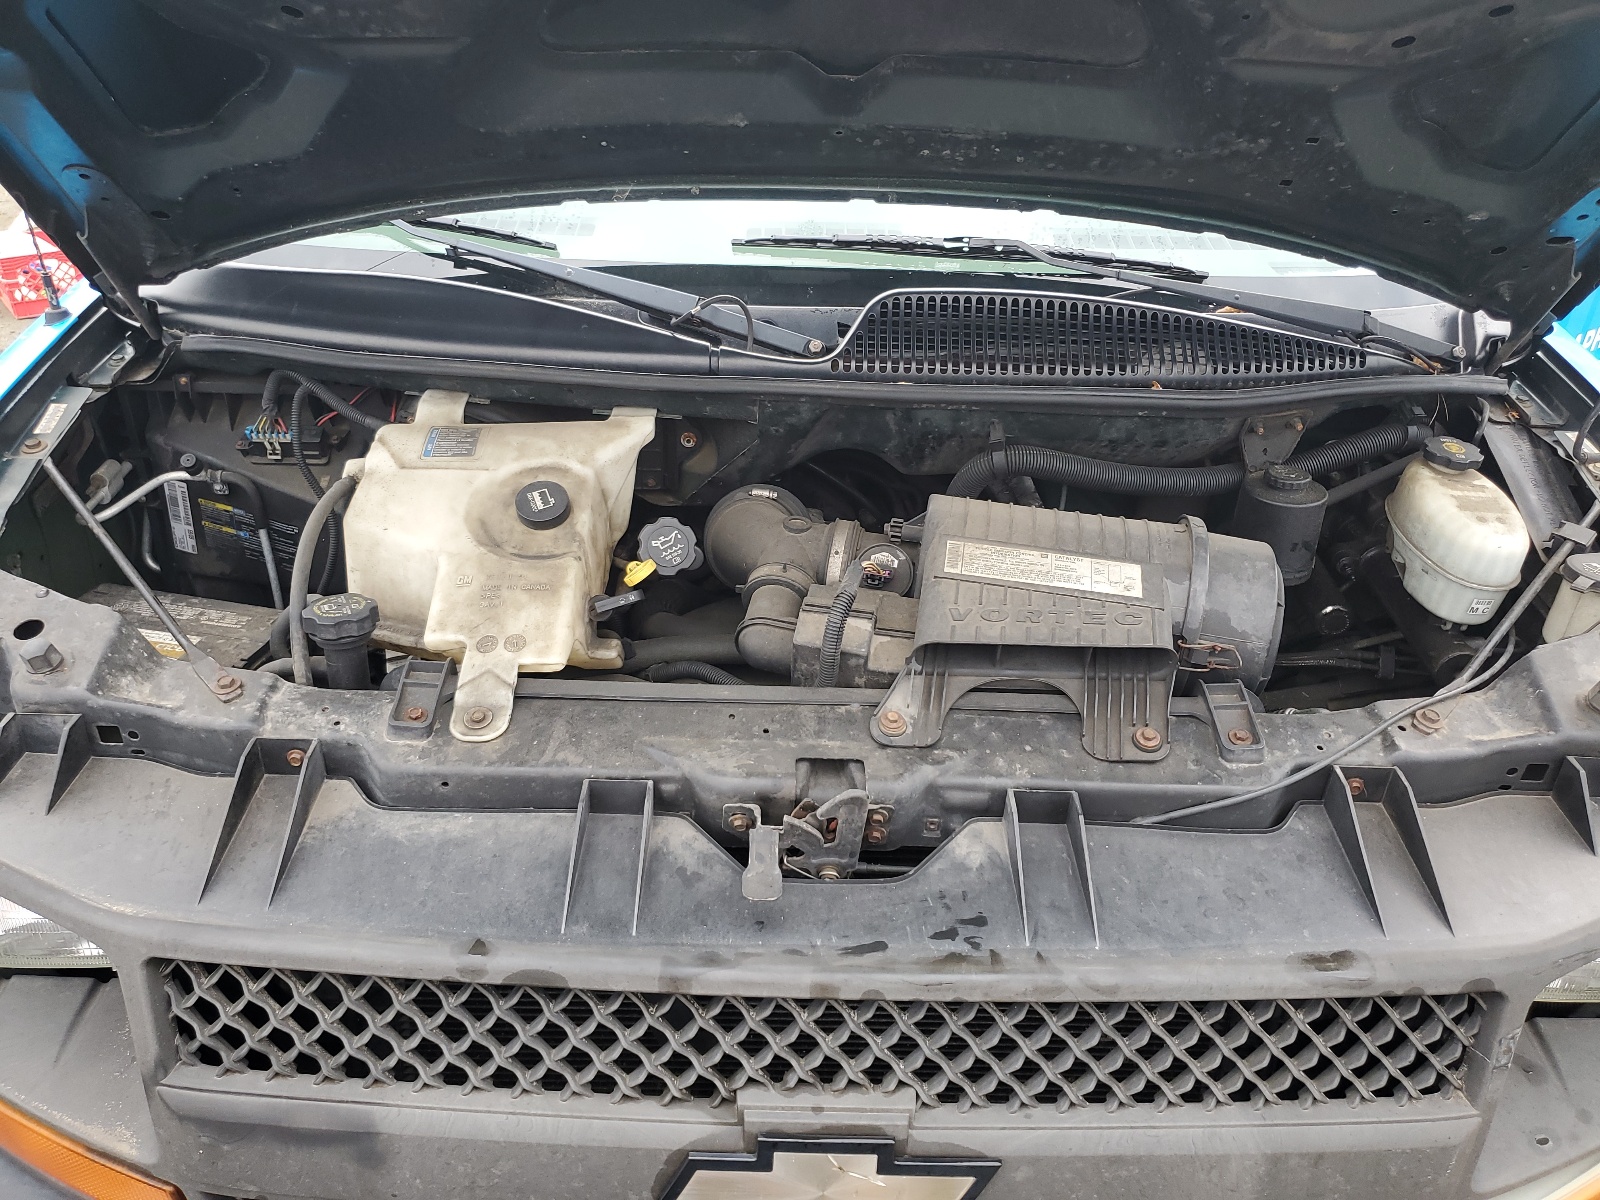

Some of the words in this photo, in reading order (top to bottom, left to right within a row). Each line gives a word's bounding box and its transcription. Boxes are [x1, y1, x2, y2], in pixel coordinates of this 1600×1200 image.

[456, 575, 473, 585] GM
[521, 583, 551, 591] CANADA
[948, 607, 1144, 626] VORTEC
